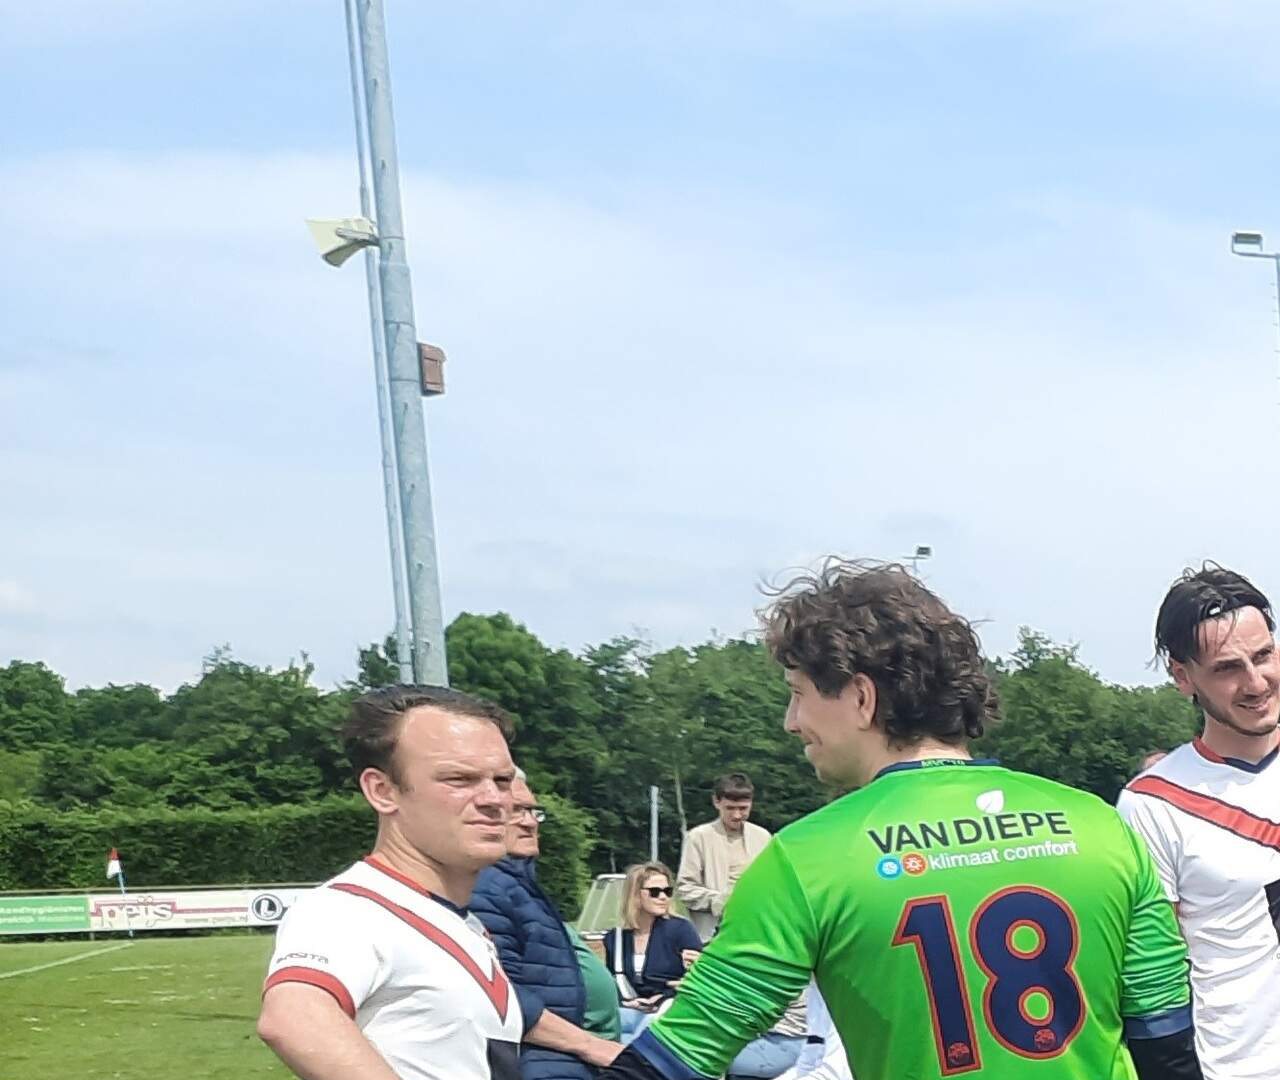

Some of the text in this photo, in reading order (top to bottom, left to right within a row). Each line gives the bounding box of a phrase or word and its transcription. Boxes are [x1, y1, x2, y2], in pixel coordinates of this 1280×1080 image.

[867, 811, 1073, 854] VAN DIEPE
[928, 840, 1080, 871] klimaat comfort
[891, 883, 1089, 1079] 18
